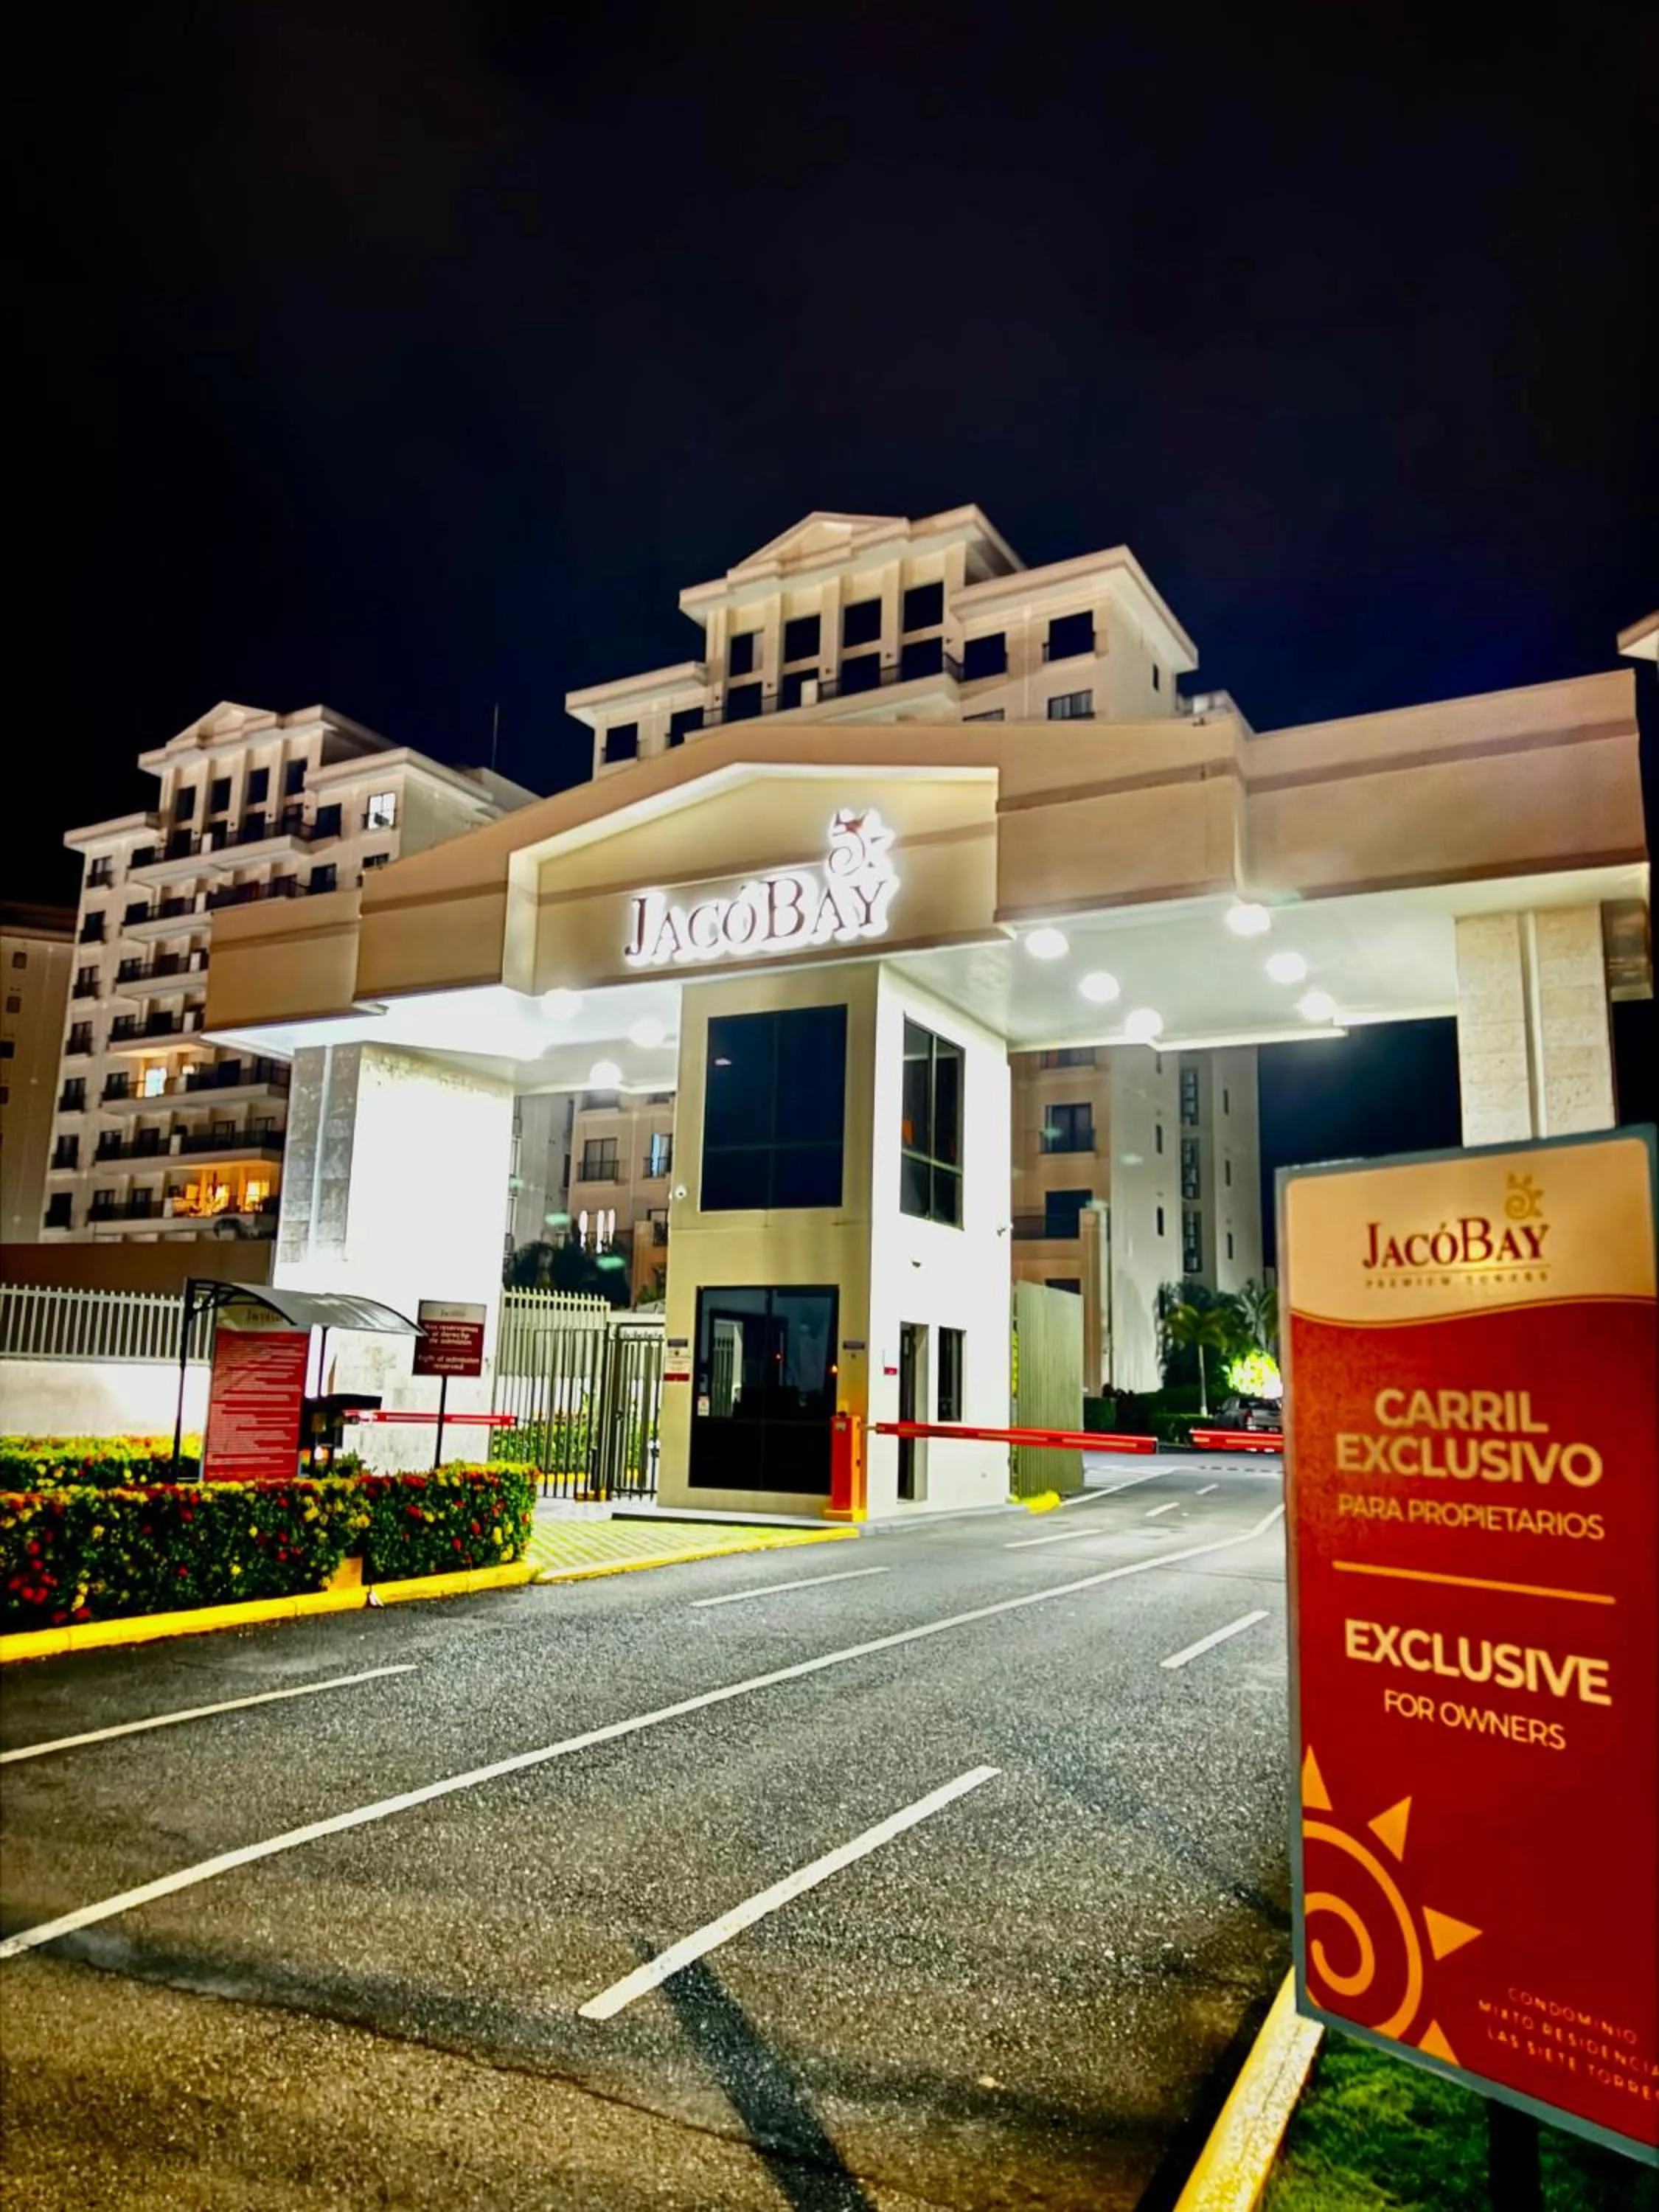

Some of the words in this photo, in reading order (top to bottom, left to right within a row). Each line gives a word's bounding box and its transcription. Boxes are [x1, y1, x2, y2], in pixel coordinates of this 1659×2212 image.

[1374, 1388, 1549, 1433] CARRIL
[1336, 1433, 1603, 1488] EXCLUSIVO
[1338, 1492, 1404, 1522] PARA
[1408, 1498, 1605, 1540] PROPIETARIOS
[1345, 1618, 1613, 1706] EXCLUSIVE
[1384, 1688, 1435, 1722] FOR
[1439, 1701, 1567, 1750] OWNERS
[1508, 1987, 1638, 2045] CONDOMINIO
[1487, 2025, 1520, 2050] LAS
[1526, 2040, 1576, 2072] SIETE
